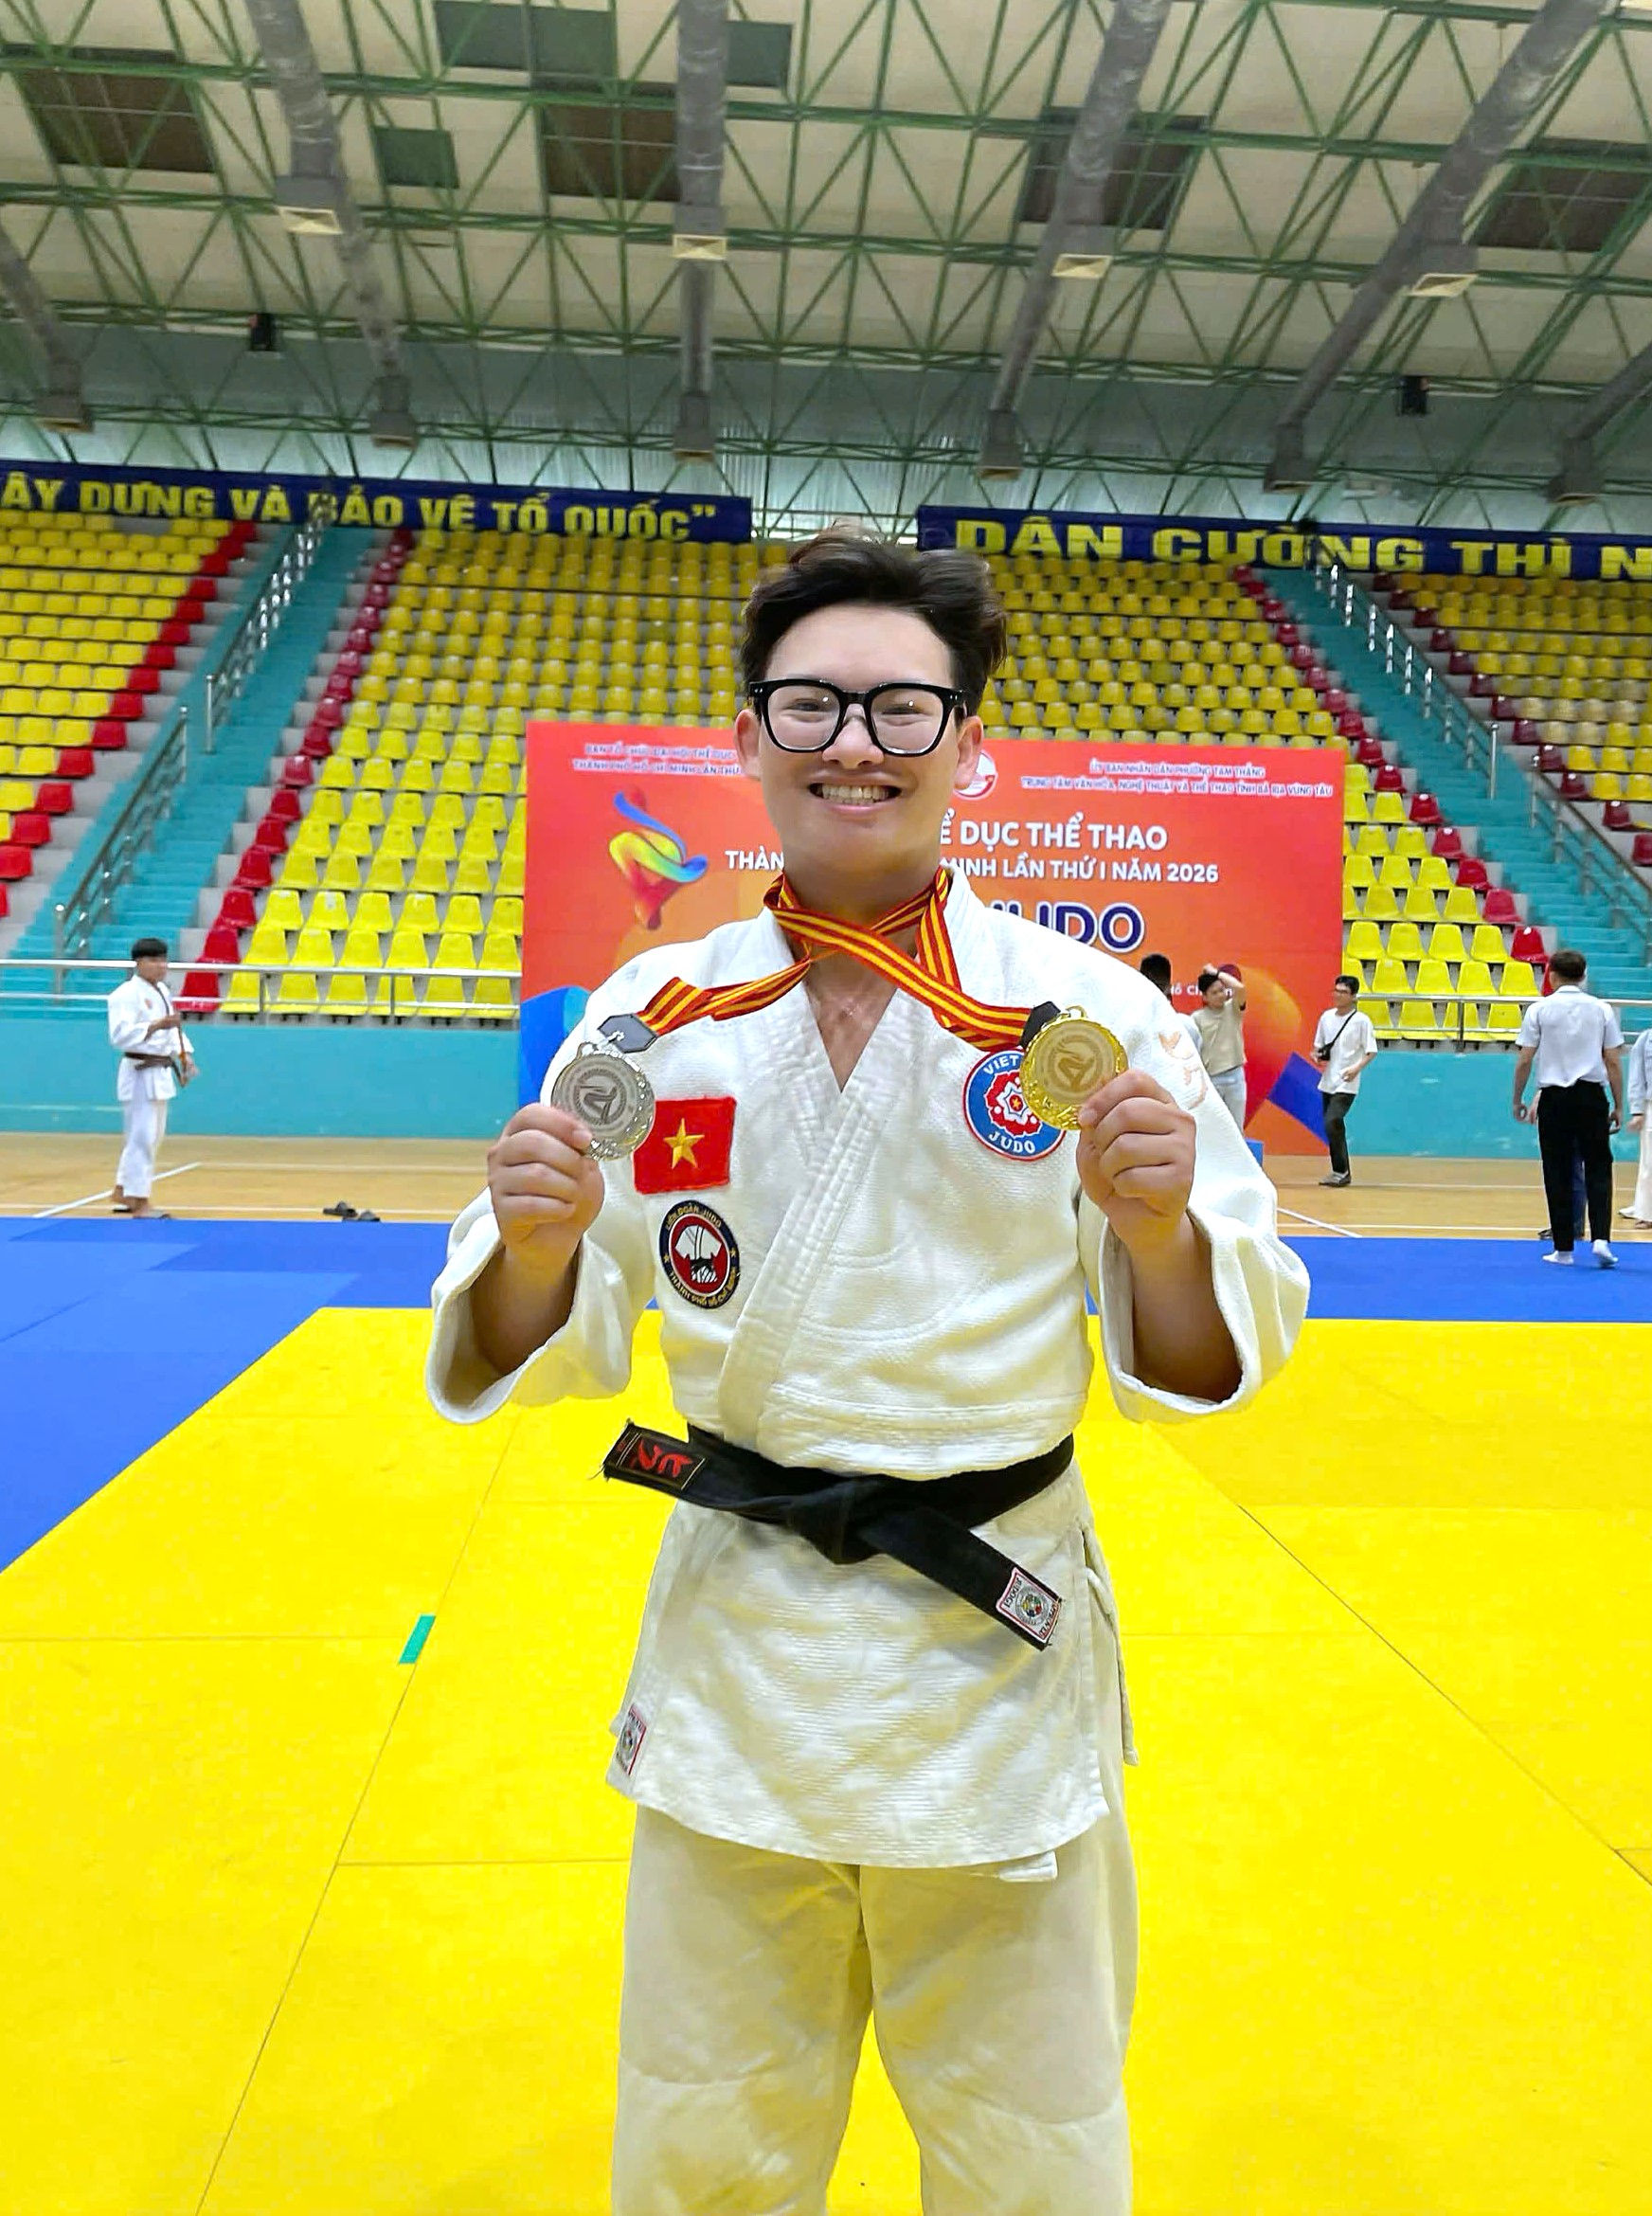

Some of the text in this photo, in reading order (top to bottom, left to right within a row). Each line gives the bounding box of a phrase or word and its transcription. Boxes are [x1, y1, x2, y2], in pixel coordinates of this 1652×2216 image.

[230, 484, 291, 520] VÀ
[492, 492, 550, 533] TỔ
[956, 515, 1123, 559] DÂN
[1449, 537, 1572, 578] THÌ
[961, 820, 1020, 853] DỤC
[1026, 812, 1084, 849] THỂ
[1087, 824, 1168, 851] THAO
[1002, 852, 1045, 879] LẦN
[1050, 854, 1097, 880] THỨ
[1099, 862, 1106, 879] I
[1111, 857, 1161, 881] NĂM
[1166, 863, 1219, 883] 2026
[989, 899, 1145, 953] DO
[983, 1054, 1019, 1075] VIET
[989, 1131, 1036, 1154] JUDO
